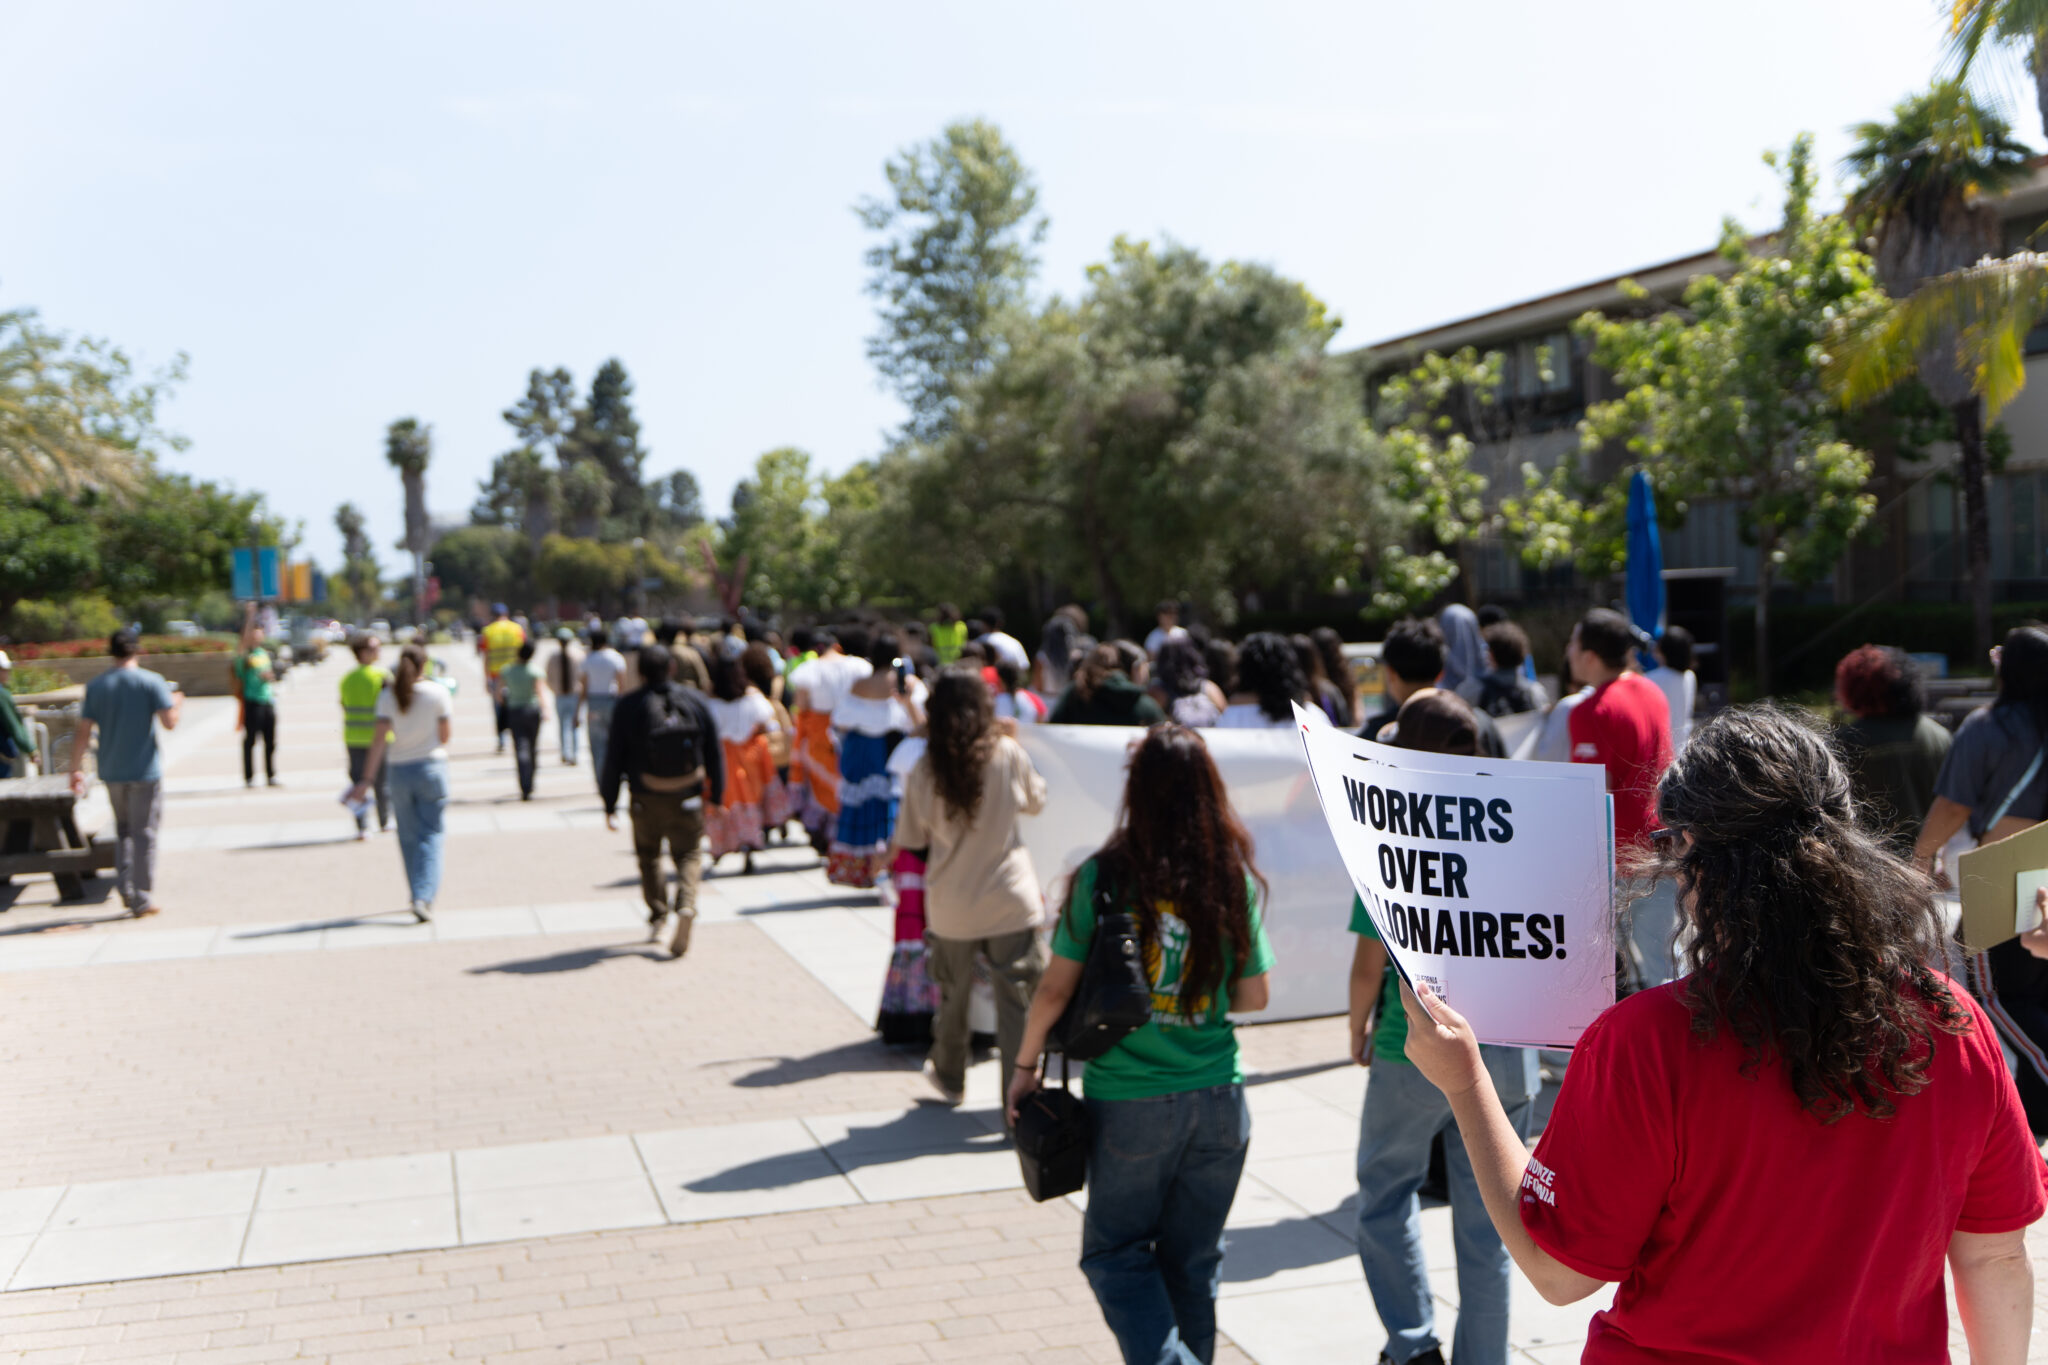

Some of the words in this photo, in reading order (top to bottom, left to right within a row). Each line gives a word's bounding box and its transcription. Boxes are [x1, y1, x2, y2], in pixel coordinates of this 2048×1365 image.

[1342, 775, 1514, 844] WORKERS
[1378, 843, 1469, 899] OVER
[1358, 877, 1567, 960] LLIONAIRES!
